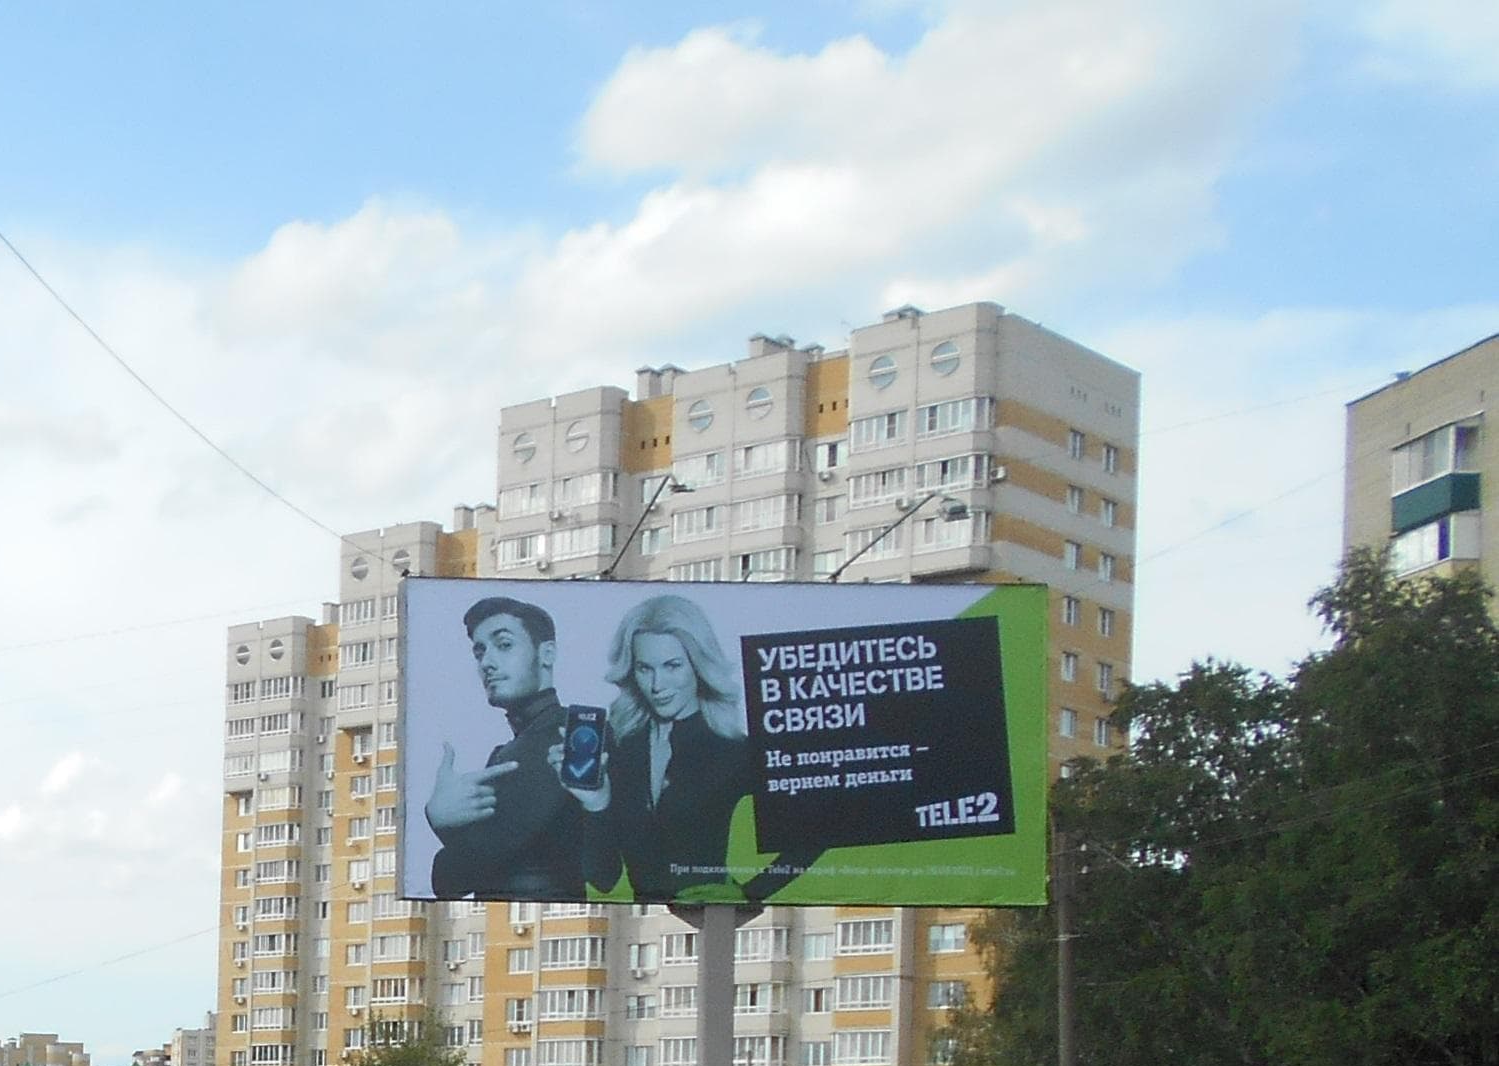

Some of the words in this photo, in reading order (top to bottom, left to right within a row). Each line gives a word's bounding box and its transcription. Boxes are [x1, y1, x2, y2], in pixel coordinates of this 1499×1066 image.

[757, 635, 937, 672] УБЕДИТЕСЬ
[760, 678, 781, 703] В
[789, 665, 945, 700] КАЧЕСТВЕ
[762, 702, 866, 734] СВЯЗИ
[765, 750, 792, 768] Не
[796, 744, 911, 768] понравится
[767, 773, 840, 796] вернем
[844, 768, 914, 789] деньги
[914, 791, 1000, 828] TELE2
[669, 863, 690, 876] При
